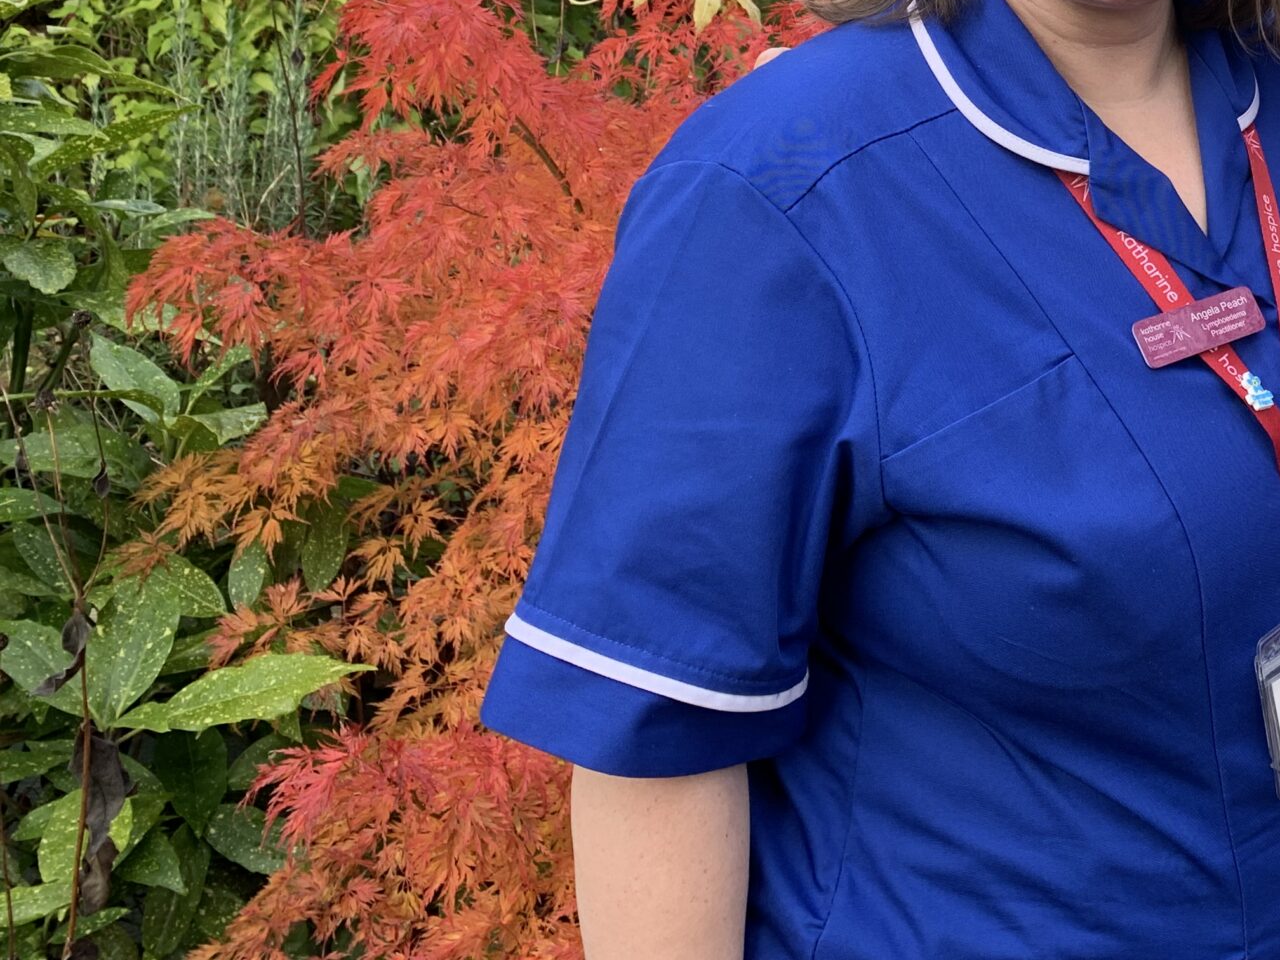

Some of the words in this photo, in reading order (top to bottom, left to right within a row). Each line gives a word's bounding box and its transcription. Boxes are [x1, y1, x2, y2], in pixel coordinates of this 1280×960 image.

[1190, 306, 1220, 322] Angela
[1220, 295, 1247, 311] Peach
[1201, 310, 1247, 331] Lymphoedema
[1211, 320, 1246, 337] Practitioner
